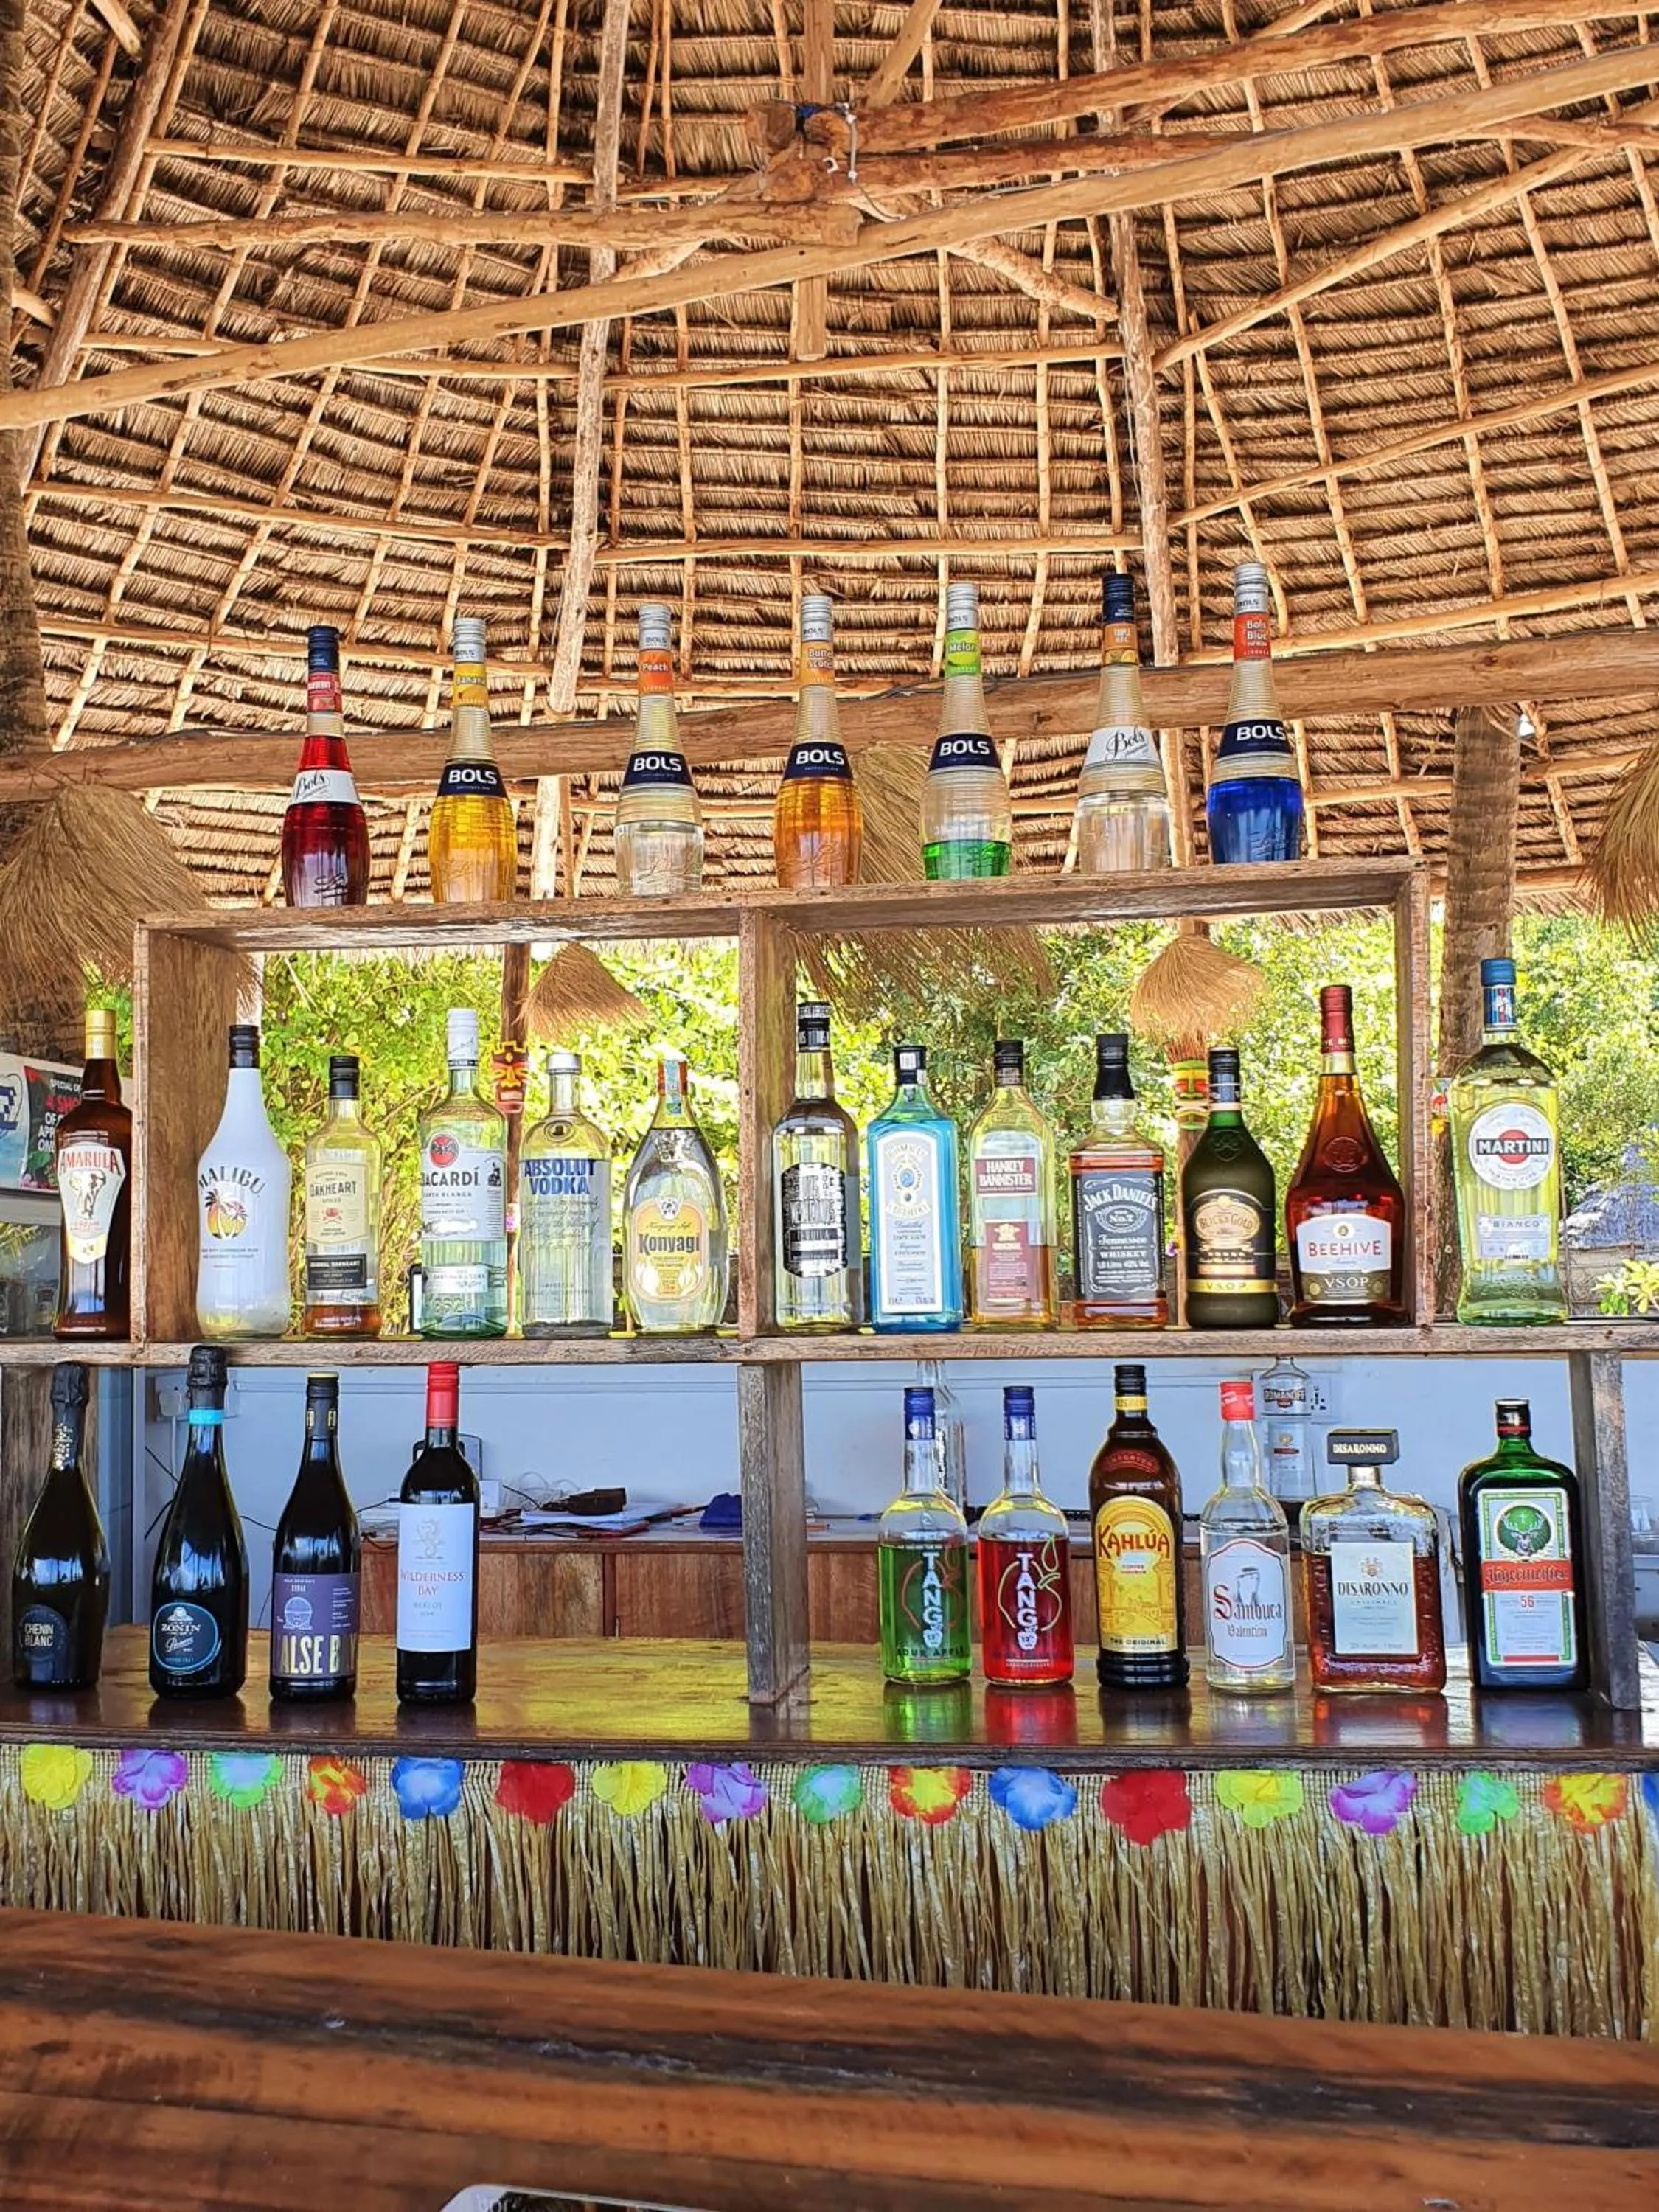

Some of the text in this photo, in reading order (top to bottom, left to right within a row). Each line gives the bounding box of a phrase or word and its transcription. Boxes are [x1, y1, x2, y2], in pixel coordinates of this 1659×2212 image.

[642, 662, 668, 672] Peach
[1237, 725, 1287, 742] BOLS
[796, 748, 845, 765] BOLS
[939, 740, 990, 757] BOLS
[633, 756, 683, 772] BOLS
[448, 768, 498, 785] BOLS
[1478, 1140, 1548, 1155] MARTINI
[60, 1150, 122, 1177] AMARULA
[524, 1159, 596, 1178] ABSOLUT
[986, 1159, 1025, 1173] HANKEY
[529, 1177, 591, 1195] VODKA
[978, 1173, 1033, 1186] BANNISTER
[309, 1181, 357, 1197] OAKHEART
[1082, 1188, 1113, 1211] JACK
[1492, 1220, 1541, 1228] BIANCO
[639, 1233, 700, 1256] Konyagi
[1307, 1240, 1383, 1257] BEEHIVE
[1324, 1276, 1370, 1289] VSOP
[1332, 1443, 1387, 1454] DISARONNO
[1097, 1524, 1171, 1559] KAHLÚA
[400, 1569, 465, 1582] WILDERNESS
[1338, 1581, 1409, 1597] DISARONNO
[1213, 1585, 1282, 1620] Sambuca
[1520, 1595, 1535, 1609] 56
[24, 1623, 54, 1635] CHENIN
[161, 1623, 201, 1632] ZONIN
[24, 1635, 54, 1647] BLANC
[277, 1635, 325, 1675] ALSE
